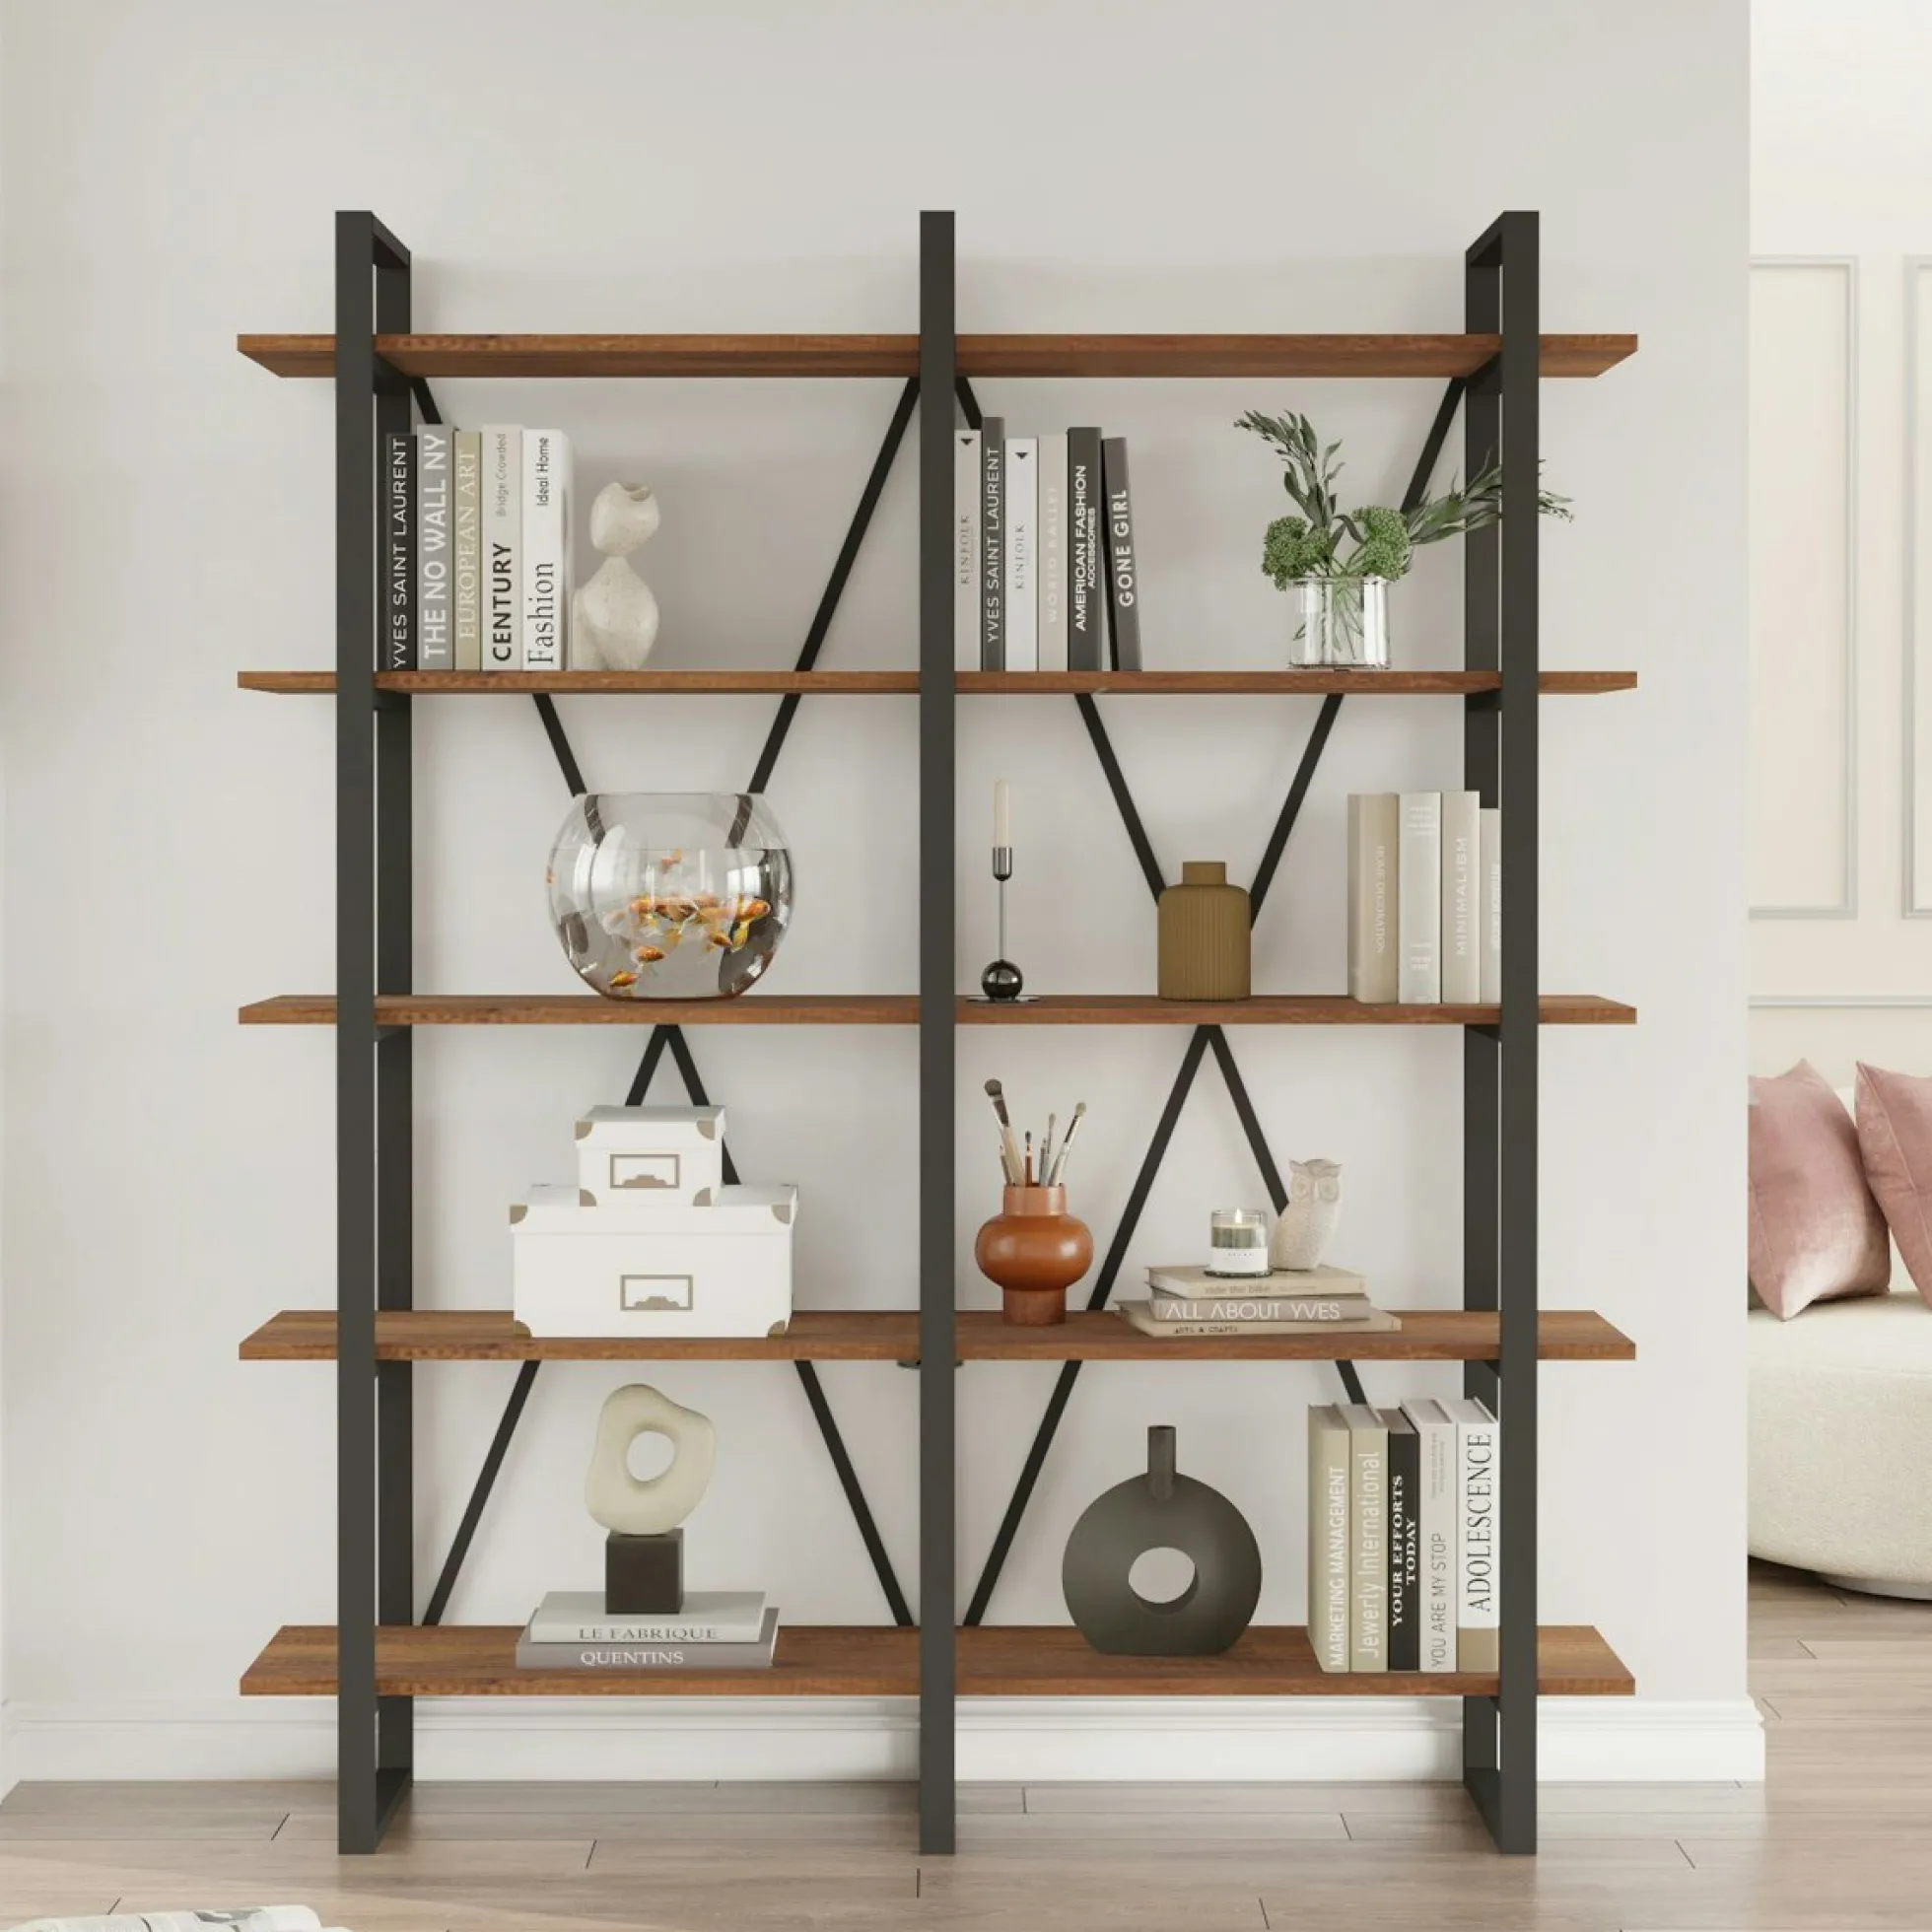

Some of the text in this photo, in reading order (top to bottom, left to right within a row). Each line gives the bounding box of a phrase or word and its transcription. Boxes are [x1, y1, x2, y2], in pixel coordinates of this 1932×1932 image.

[536, 437, 549, 507] Ideal Home
[393, 438, 407, 668] YVES SAINT LAURENT
[424, 433, 447, 658] THE NO WALL NY
[458, 449, 477, 640] EUROPEAN ART
[492, 542, 513, 662] CENTURY
[987, 447, 1000, 643] YVES SAINT LAURENT
[1074, 465, 1087, 632] AMERICAN FASHION
[1087, 507, 1096, 589] ACCESSORIES
[1112, 489, 1134, 608] GONE GIRL
[527, 562, 554, 665] Fashion
[1455, 837, 1469, 956] MINIMALISM
[1166, 1302, 1341, 1320] ALL ABOUT YVES
[1329, 1467, 1346, 1666] MARKETING MANAGEMENT
[1357, 1452, 1386, 1658] Jewerly International
[1392, 1475, 1404, 1626] YOUR EFFORTS
[1406, 1517, 1416, 1585] TODAY
[1467, 1433, 1492, 1613] ADOLESCENCE
[580, 1627, 719, 1641] LE FABRIQUE
[580, 1650, 684, 1666] QUENTINS
[1429, 1533, 1447, 1669] YOU ARE MY STOP
